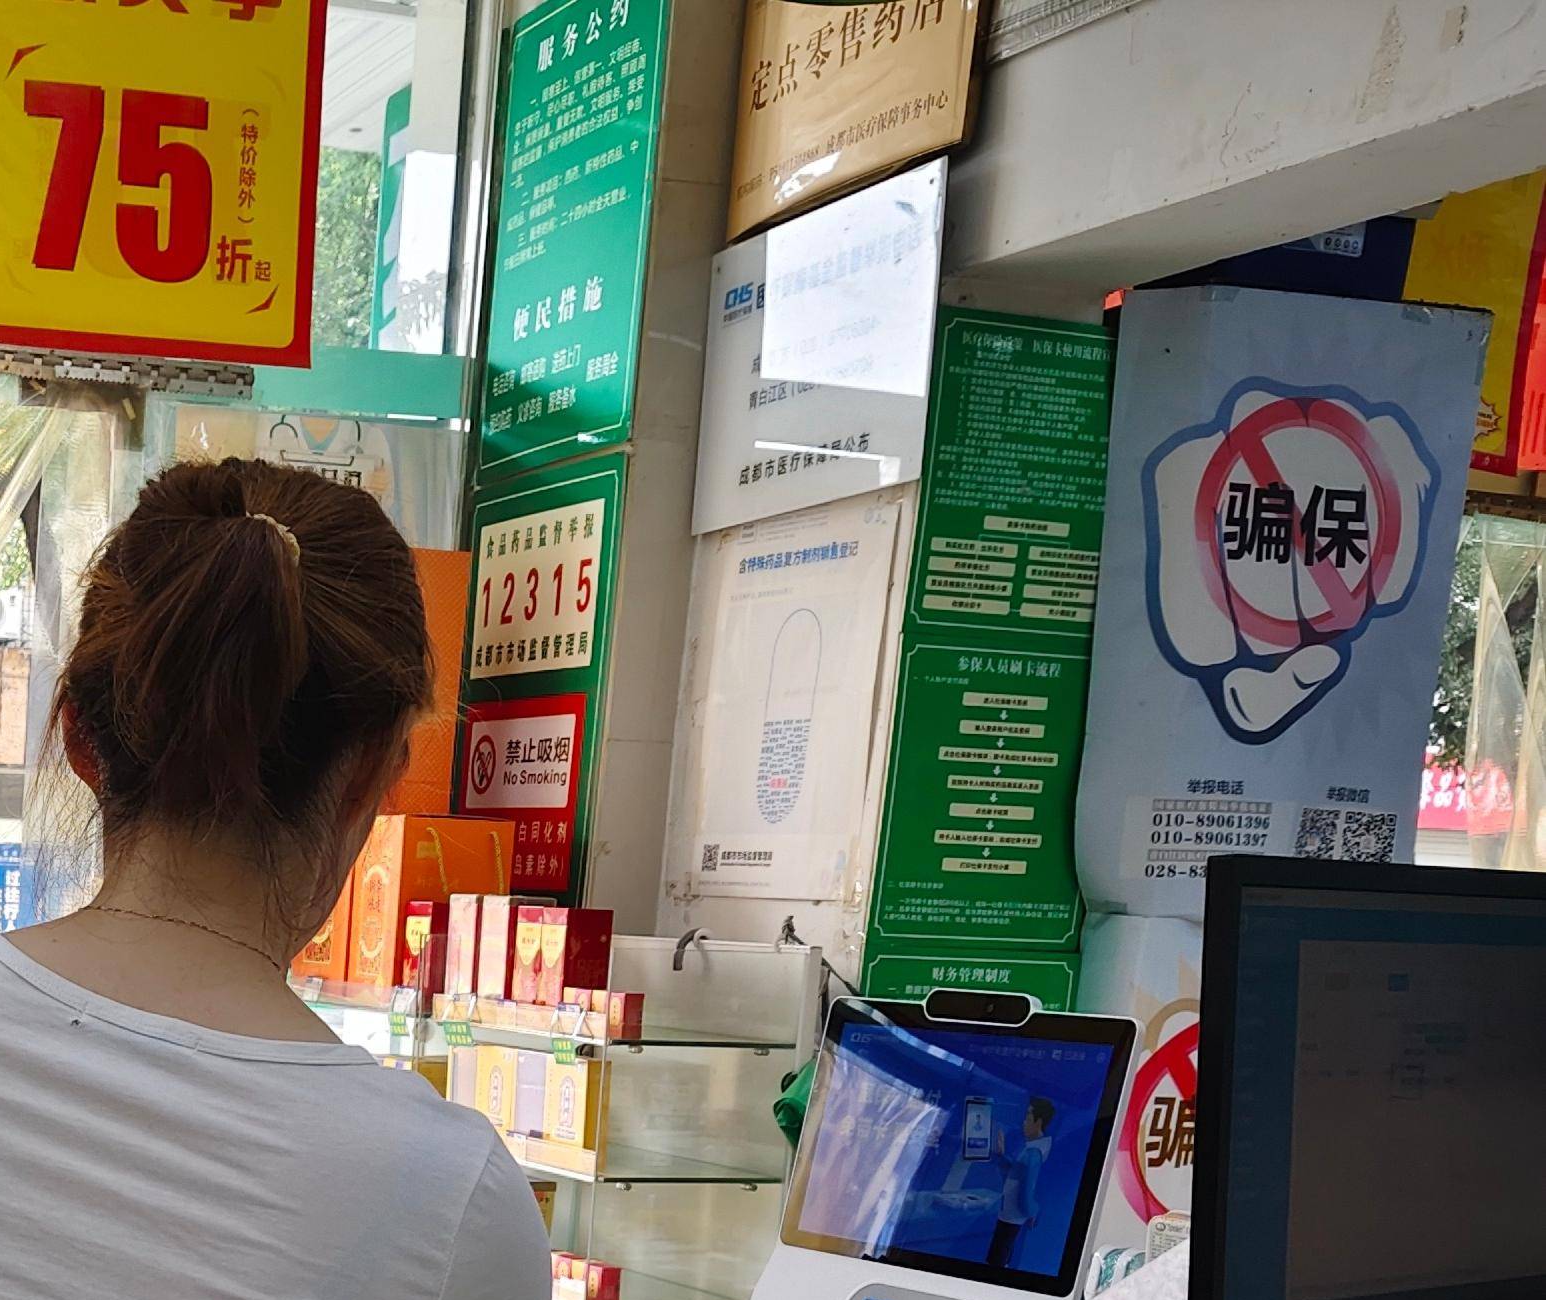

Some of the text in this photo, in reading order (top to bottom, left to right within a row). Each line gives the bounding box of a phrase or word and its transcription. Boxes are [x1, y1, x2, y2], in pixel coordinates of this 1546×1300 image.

[536, 0, 631, 72] 服务公约
[748, 0, 944, 116] 定点零售药店
[23, 79, 212, 283] 75
[514, 276, 604, 342] 便民措施
[485, 513, 595, 559] 食品药品监督举报
[1221, 482, 1370, 569] 骗保
[481, 558, 594, 628] 12315
[474, 631, 588, 667] 成都市市场监督管理局
[958, 656, 1062, 678] 参保人员刷卡流程
[504, 736, 570, 765] 禁止吸烟
[503, 769, 567, 788] No Smoking
[1187, 780, 1244, 795] 举报电话
[1150, 830, 1269, 847] 010-89061397
[1152, 813, 1271, 830] 010-89061396
[932, 966, 1012, 985] 财务管理制度
